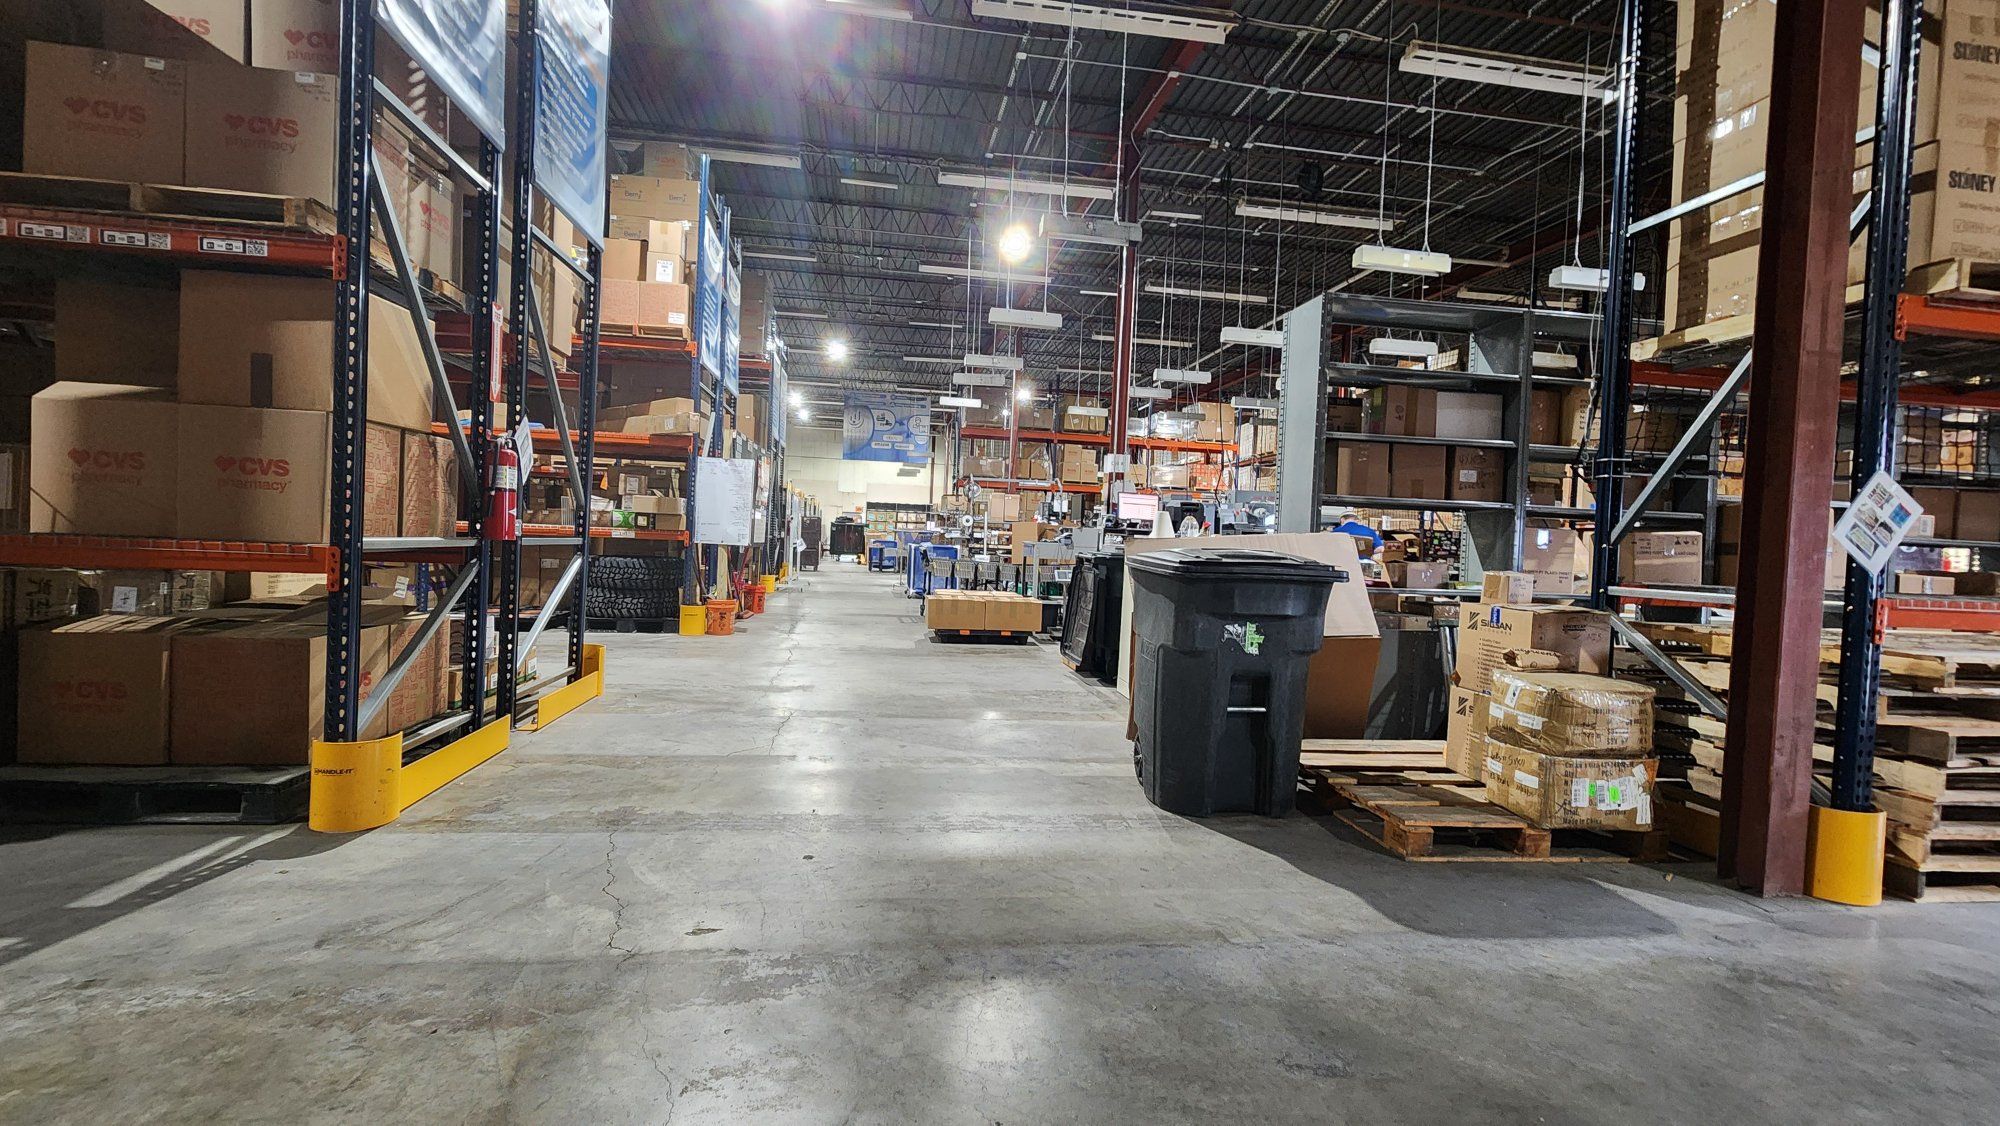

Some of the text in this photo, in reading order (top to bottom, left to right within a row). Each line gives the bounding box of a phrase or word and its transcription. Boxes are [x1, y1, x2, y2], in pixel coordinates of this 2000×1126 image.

[247, 116, 299, 138] CVS
[1948, 170, 1996, 193] SIDNEY
[93, 451, 145, 470] CVS
[238, 457, 290, 478] CVS
